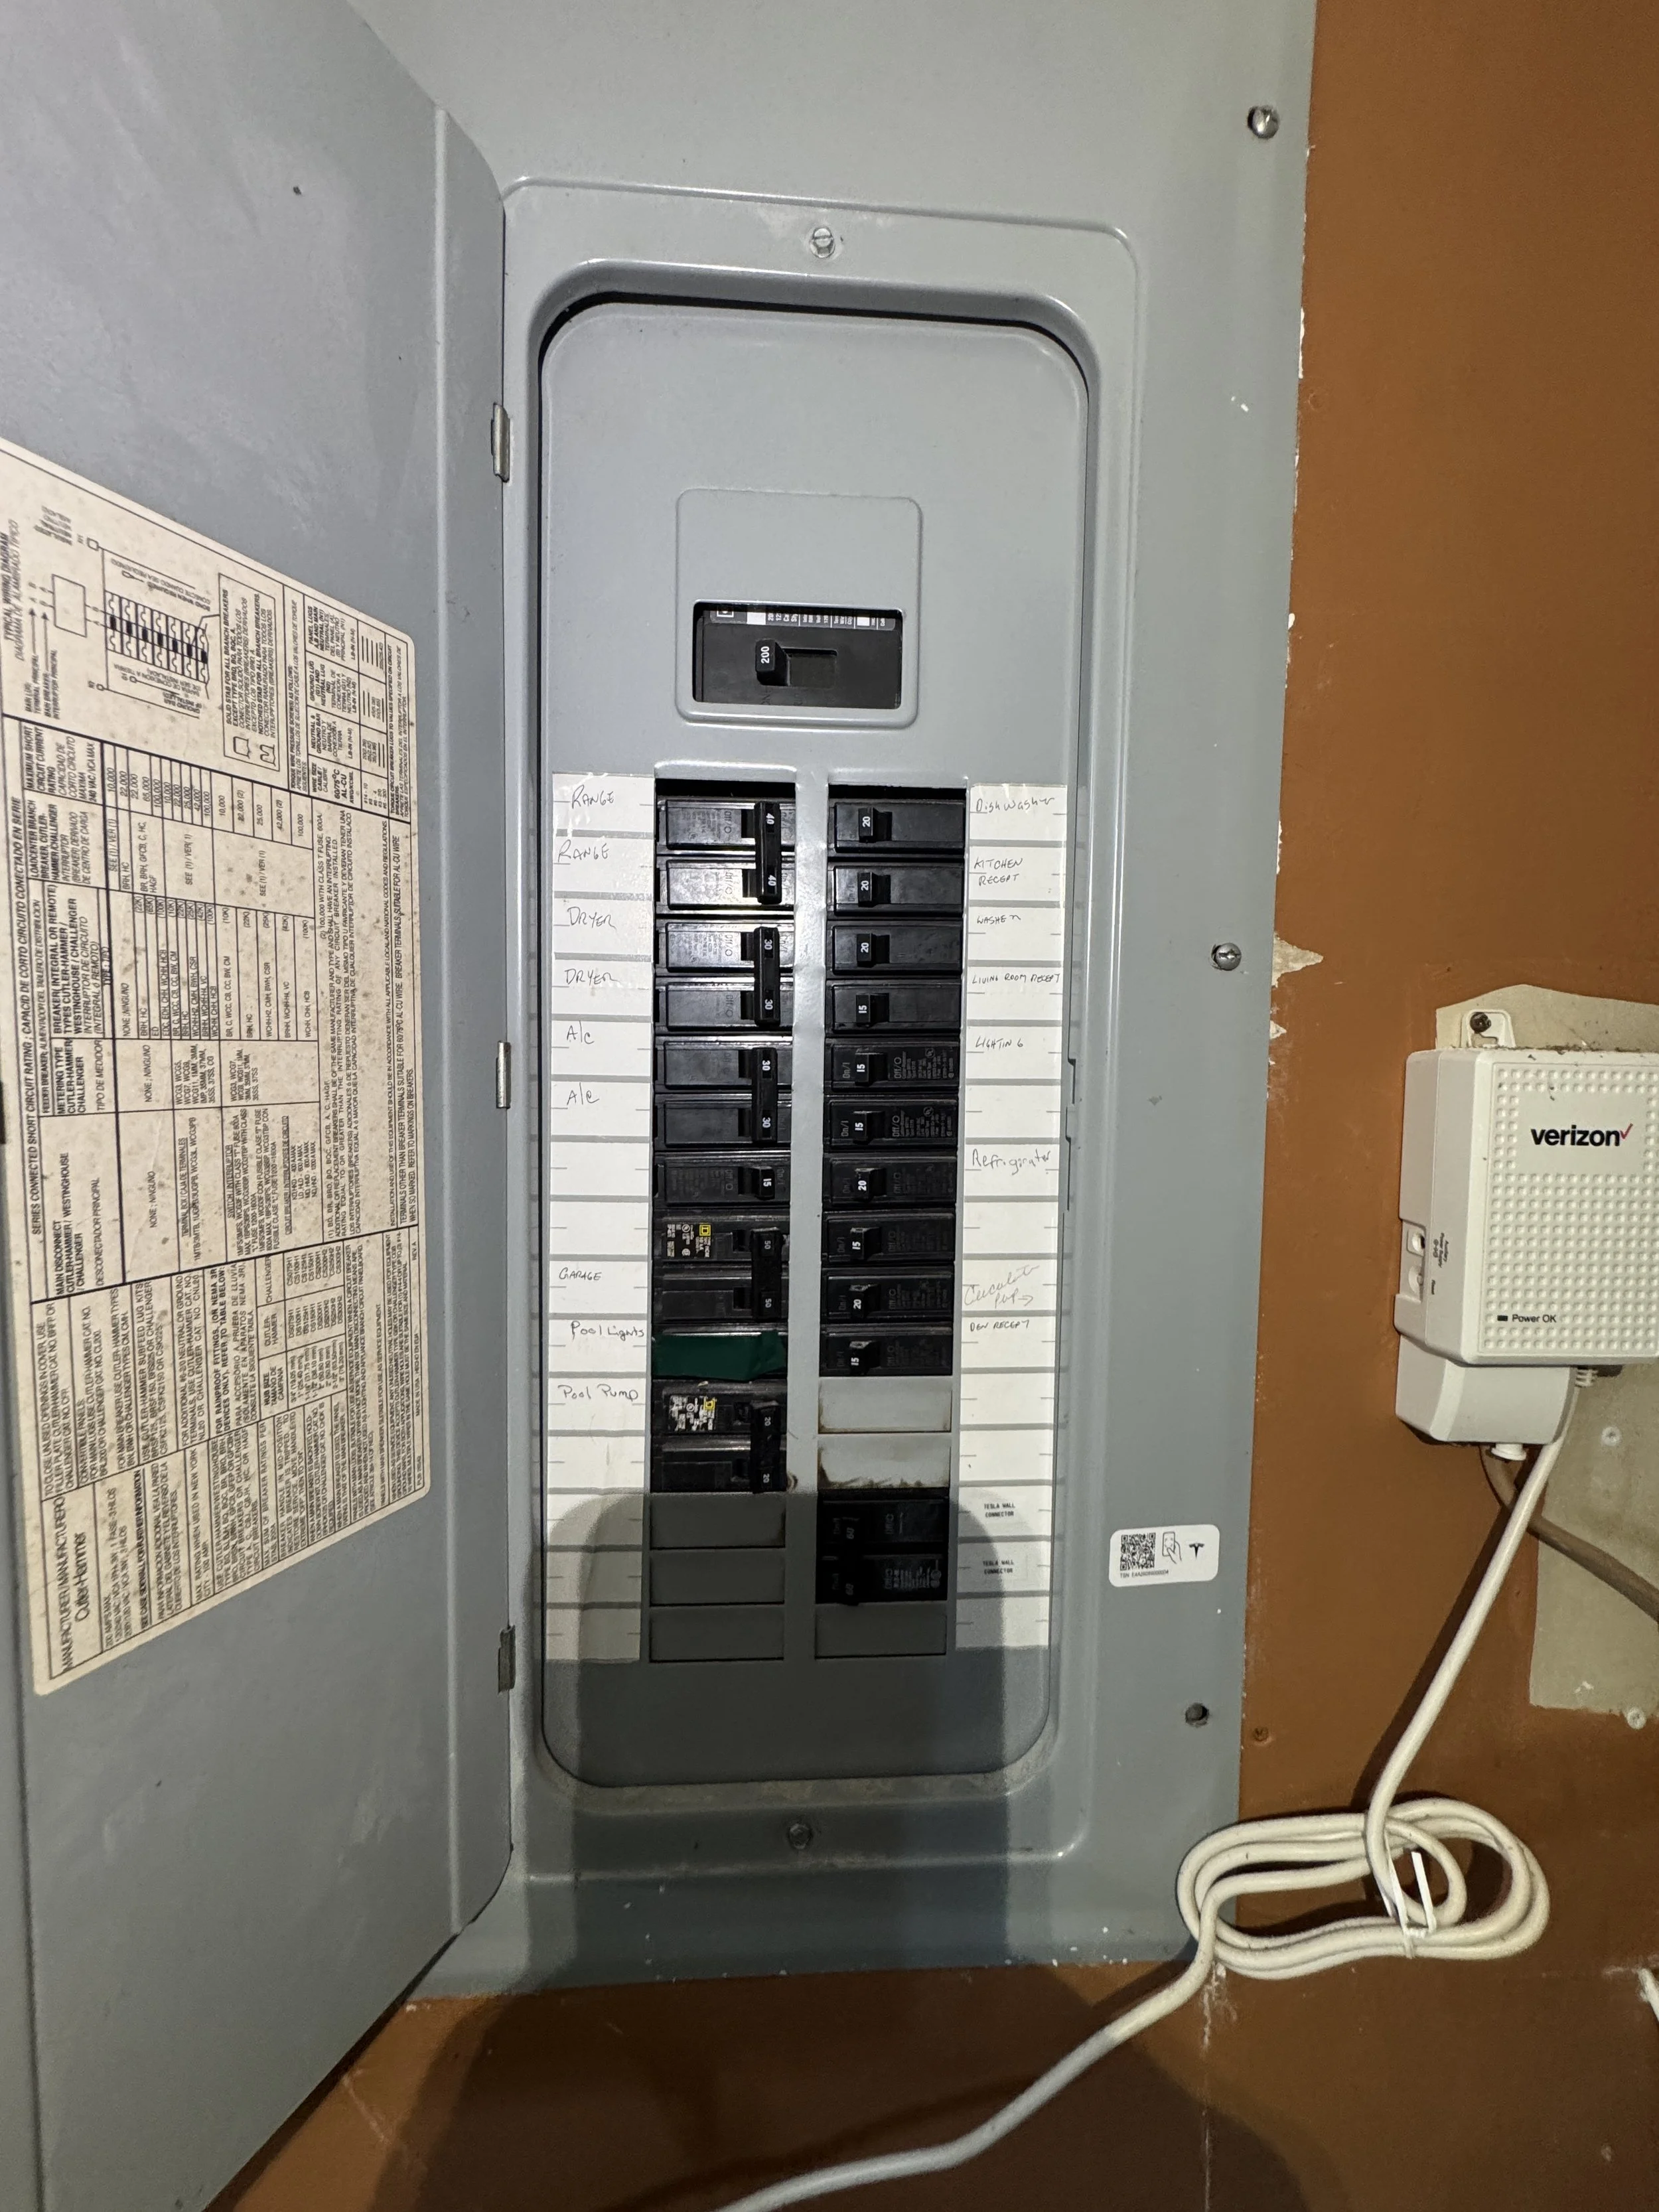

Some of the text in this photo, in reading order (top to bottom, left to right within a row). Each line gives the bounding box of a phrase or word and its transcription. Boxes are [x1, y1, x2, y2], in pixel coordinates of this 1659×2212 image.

[760, 645, 770, 664] 200
[24, 725, 35, 789] MAXIMUM SHORT
[35, 726, 46, 791] CIRCUIT CURRENT
[46, 765, 56, 793] RATING
[153, 778, 161, 808] 100,000
[571, 784, 614, 808] RANGE
[11, 796, 22, 825] SERIE
[766, 812, 775, 826] 40
[863, 816, 871, 828] 20
[13, 827, 23, 840] EN
[557, 839, 609, 863] RANGE
[13, 842, 26, 899] CONECTADO
[974, 858, 1023, 869] KITCHEN
[768, 874, 776, 887] 40
[861, 879, 869, 891] 20
[134, 895, 143, 913] (22K)
[146, 897, 155, 915] (65K)
[157, 898, 166, 918] (100K)
[16, 901, 28, 944] CIRCUITO
[567, 906, 616, 928] DRYER
[764, 938, 773, 951] 30
[861, 942, 869, 954] 20
[19, 946, 29, 978] CORTO
[1005, 973, 1027, 982] ROOM
[20, 980, 30, 991] DE
[764, 998, 773, 1010] 30
[858, 1005, 867, 1014] 15
[21, 995, 32, 1034] CAPACID
[23, 1042, 33, 1074] RATING
[762, 1059, 770, 1071] 30
[857, 1064, 865, 1072] 15
[25, 1076, 35, 1112] CIRCUIT
[27, 1113, 37, 1144] SHORT
[762, 1116, 771, 1128] 30
[1530, 1124, 1621, 1147] verizon
[338, 1154, 345, 1165] OR
[28, 1146, 40, 1201] CONNECTED
[339, 1169, 345, 1179] TO
[763, 1178, 772, 1187] 15
[857, 1180, 867, 1191] 20
[31, 1203, 41, 1234] SERIES
[763, 1240, 771, 1250] 50
[852, 1241, 861, 1250] 15
[52, 1219, 64, 1295] MAIN DISCONNECT
[210, 1267, 218, 1280] 3R
[559, 1267, 603, 1281] GARAGE
[135, 1282, 143, 1303] KITS
[765, 1297, 772, 1308] 50
[853, 1299, 861, 1309] 20
[136, 1304, 145, 1323] LUG
[1512, 1313, 1557, 1324] Power OK
[220, 1327, 227, 1338] TO
[571, 1321, 645, 1342] Pool Lights
[970, 1321, 989, 1331] DEN
[137, 1325, 146, 1365] SUBFEED
[851, 1357, 859, 1366] 15
[222, 1368, 230, 1396] ONLY).
[557, 1384, 639, 1401] Pool Pump
[139, 1367, 150, 1441] CUTLER-HAMMER
[764, 1416, 771, 1427] 20
[763, 1473, 770, 1484] 20
[71, 1529, 90, 1623] Cutler-Hammer
